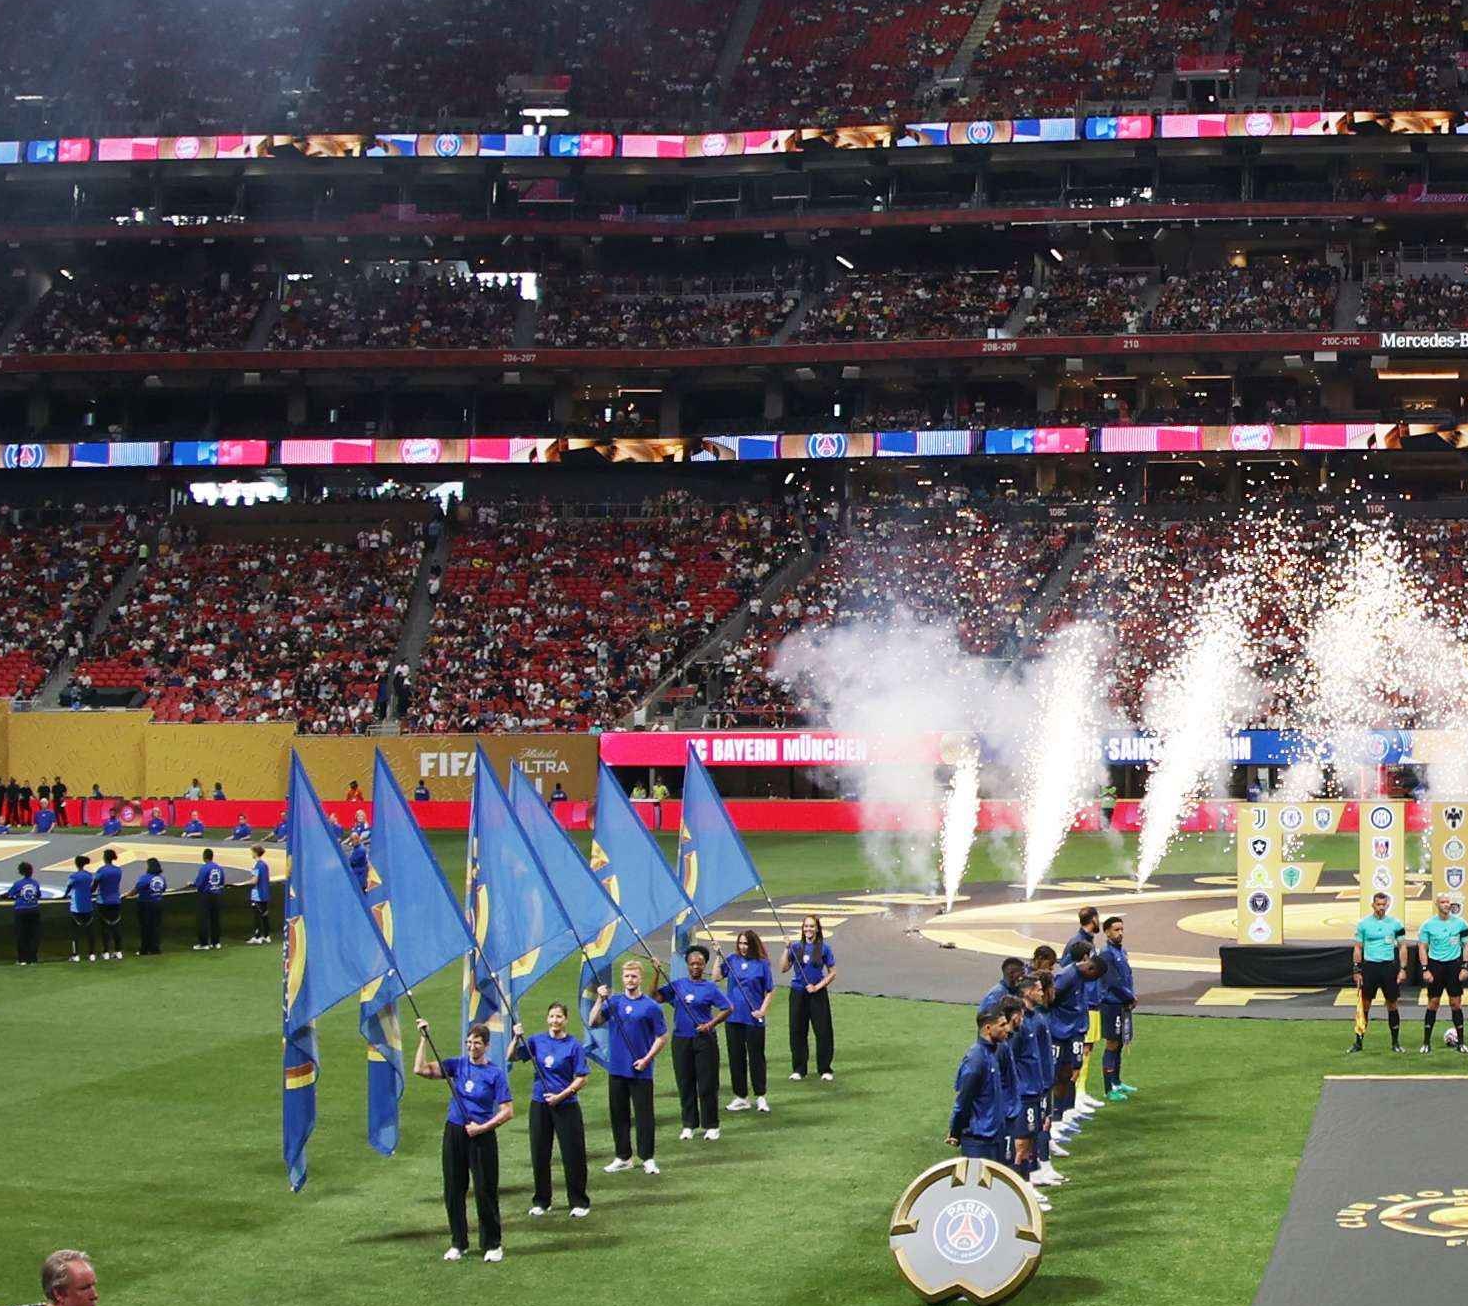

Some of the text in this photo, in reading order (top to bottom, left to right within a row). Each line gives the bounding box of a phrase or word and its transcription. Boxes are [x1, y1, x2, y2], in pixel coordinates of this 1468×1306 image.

[982, 342, 1018, 352] 208-209
[1123, 340, 1140, 349] 210
[502, 353, 537, 363] 206-207
[711, 738, 778, 763] BAYERN
[785, 732, 867, 763] MÜNCHEN
[1026, 1108, 1035, 1123] 8
[946, 1203, 989, 1220] PARIS
[1333, 1191, 1382, 1230] CLUB
